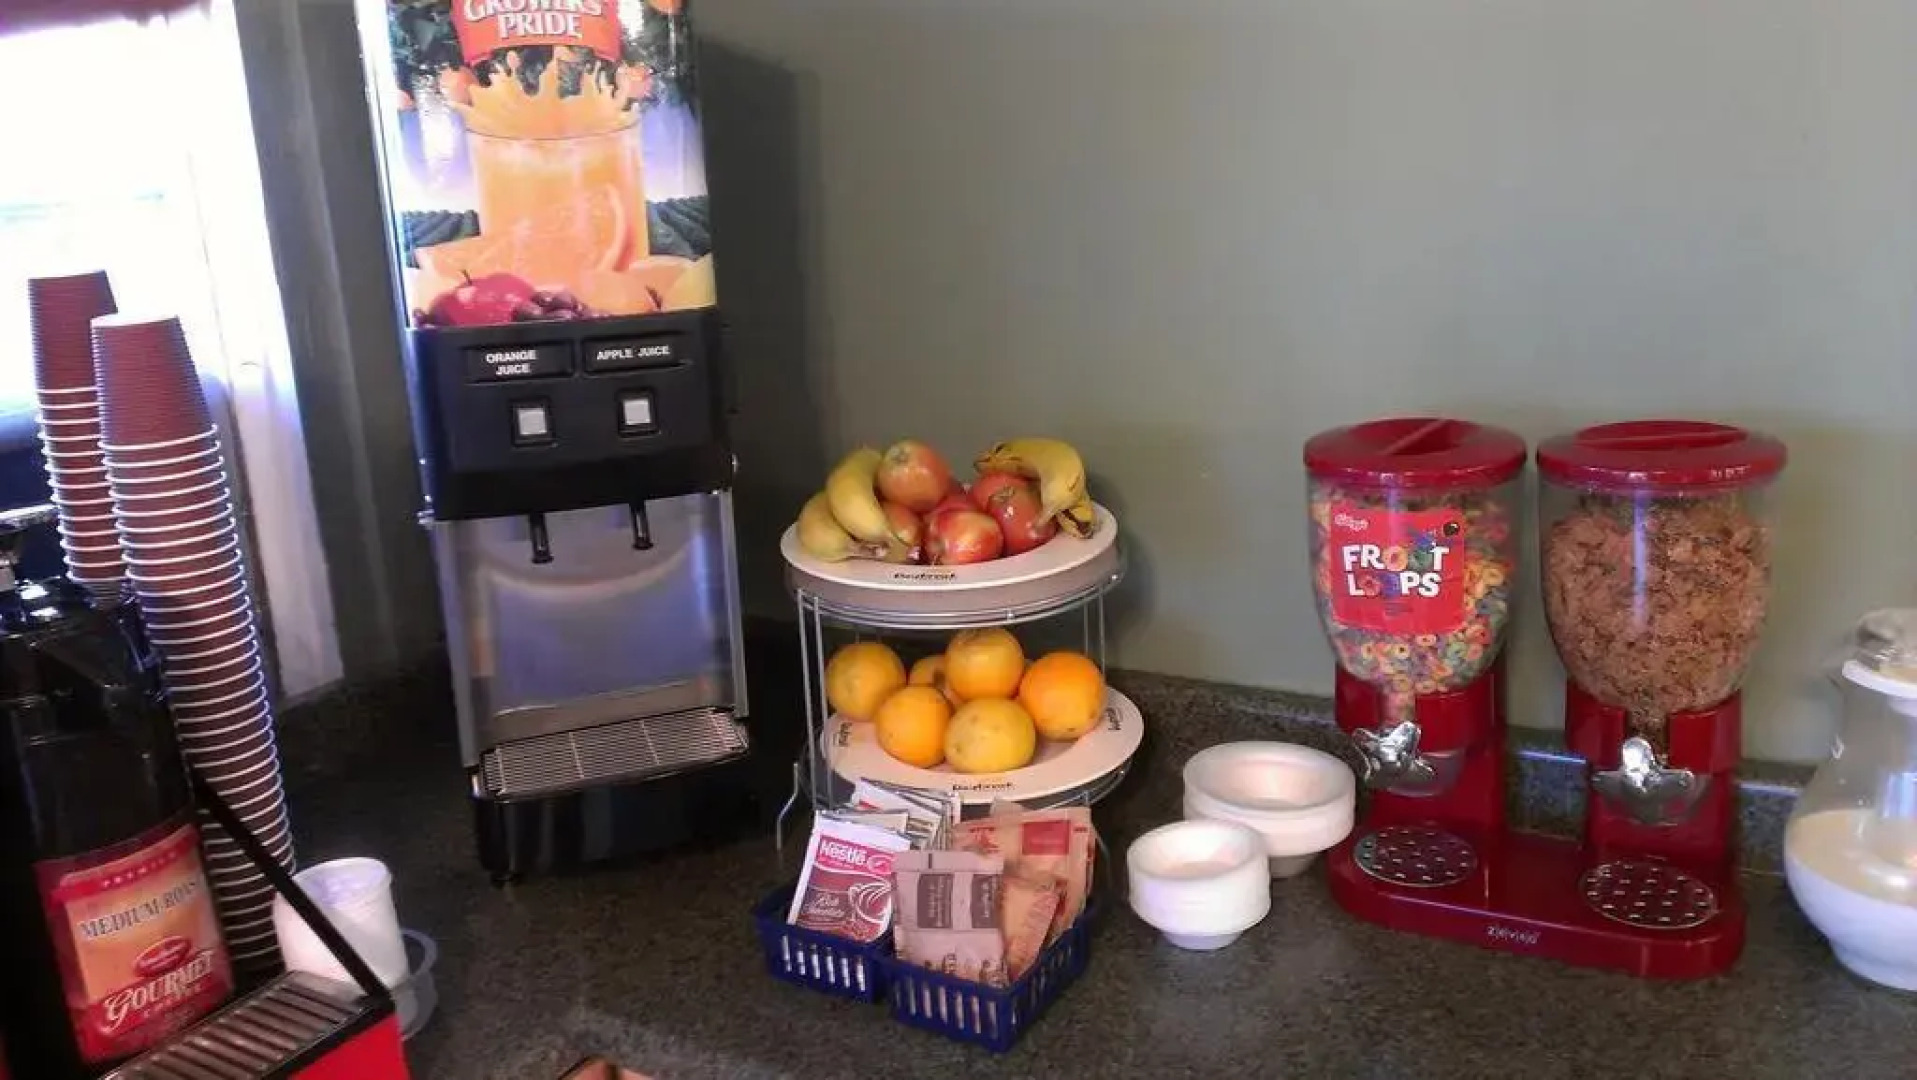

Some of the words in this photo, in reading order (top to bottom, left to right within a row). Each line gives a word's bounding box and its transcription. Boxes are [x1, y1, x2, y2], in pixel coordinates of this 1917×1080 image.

[498, 12, 583, 38] PRIDE
[486, 349, 538, 363] ORANGE
[596, 348, 634, 360] APPLE
[638, 345, 671, 357] JUICE
[496, 363, 532, 376] JUICE
[1342, 544, 1450, 572] FROOT
[1347, 571, 1442, 597] LOOPS
[80, 900, 160, 938] MEDIUM
[98, 950, 214, 1034] GOURMET
